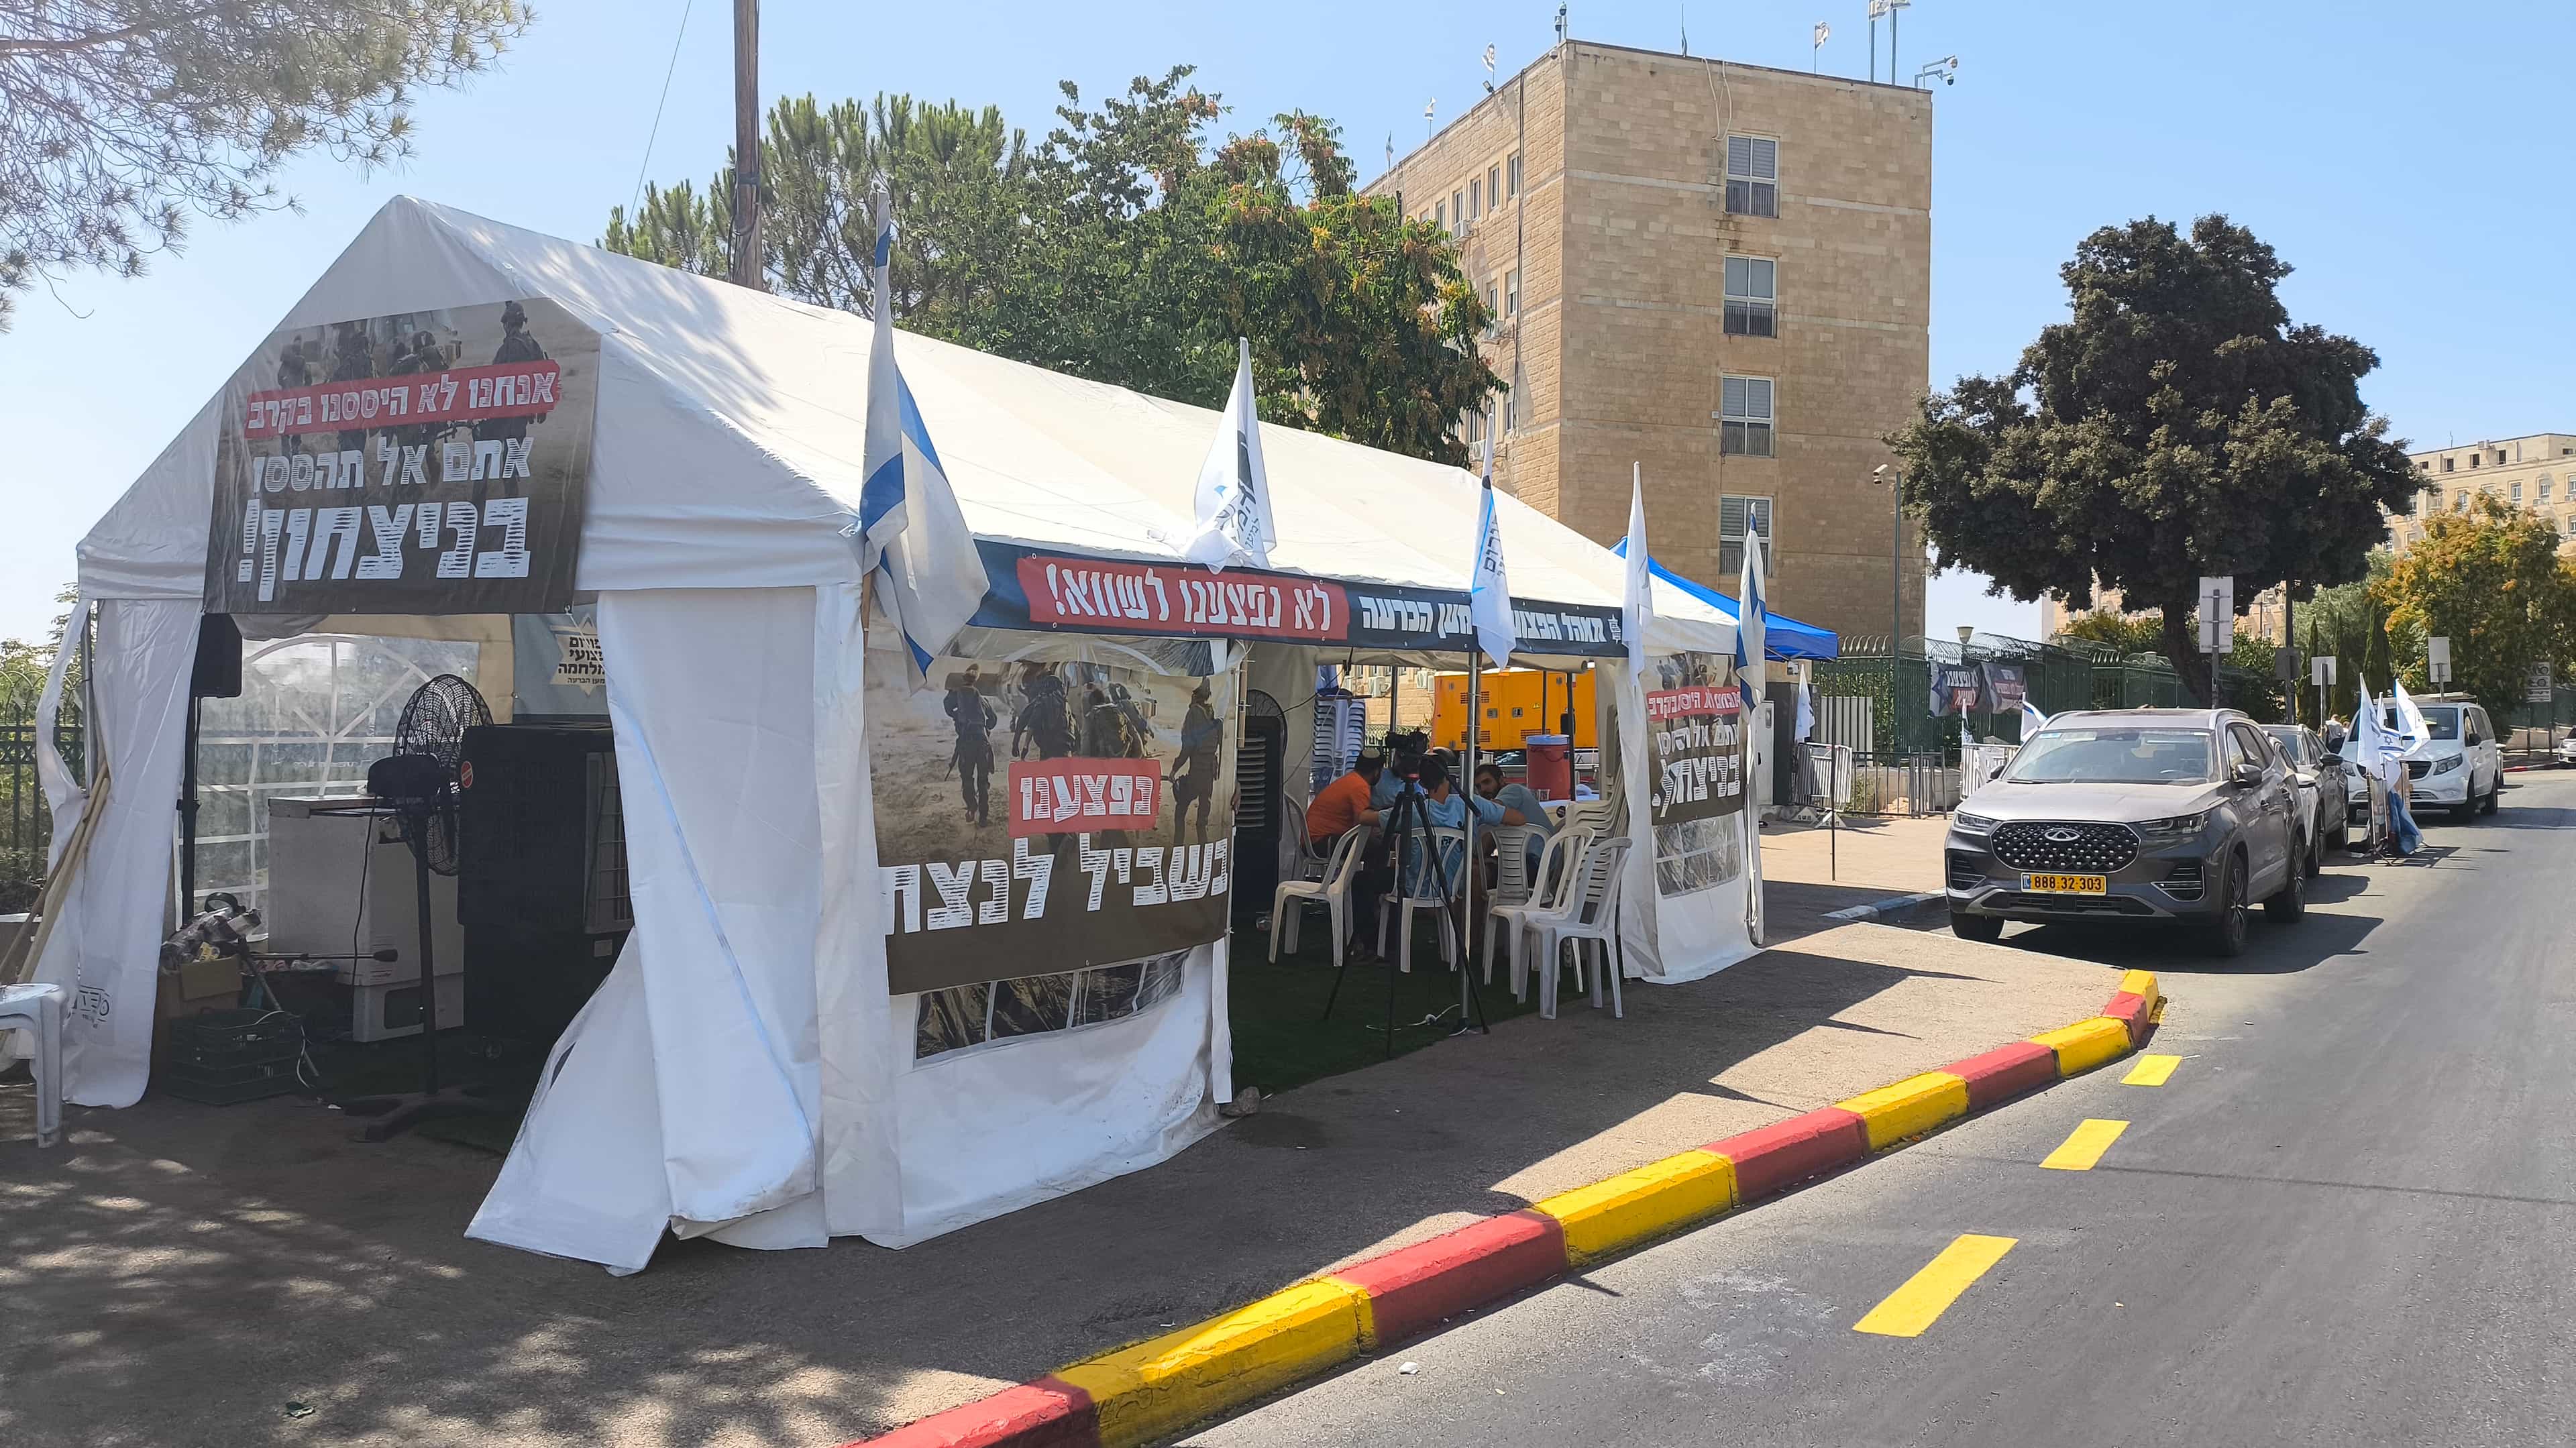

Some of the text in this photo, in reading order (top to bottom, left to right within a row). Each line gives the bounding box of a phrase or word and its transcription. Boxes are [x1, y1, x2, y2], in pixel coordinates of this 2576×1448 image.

[248, 372, 556, 435] אנחנו לא היססנו בקרב
[254, 437, 534, 493] אתם אל תהססו
[237, 497, 531, 602] בניצחון!
[1046, 563, 1330, 630] לא נפצענו לשווא!
[1358, 596, 1432, 632] הכרעה
[1438, 603, 1472, 639] מען
[1020, 773, 1153, 822] נפצענו
[878, 833, 1228, 936] בשביל לנצח
